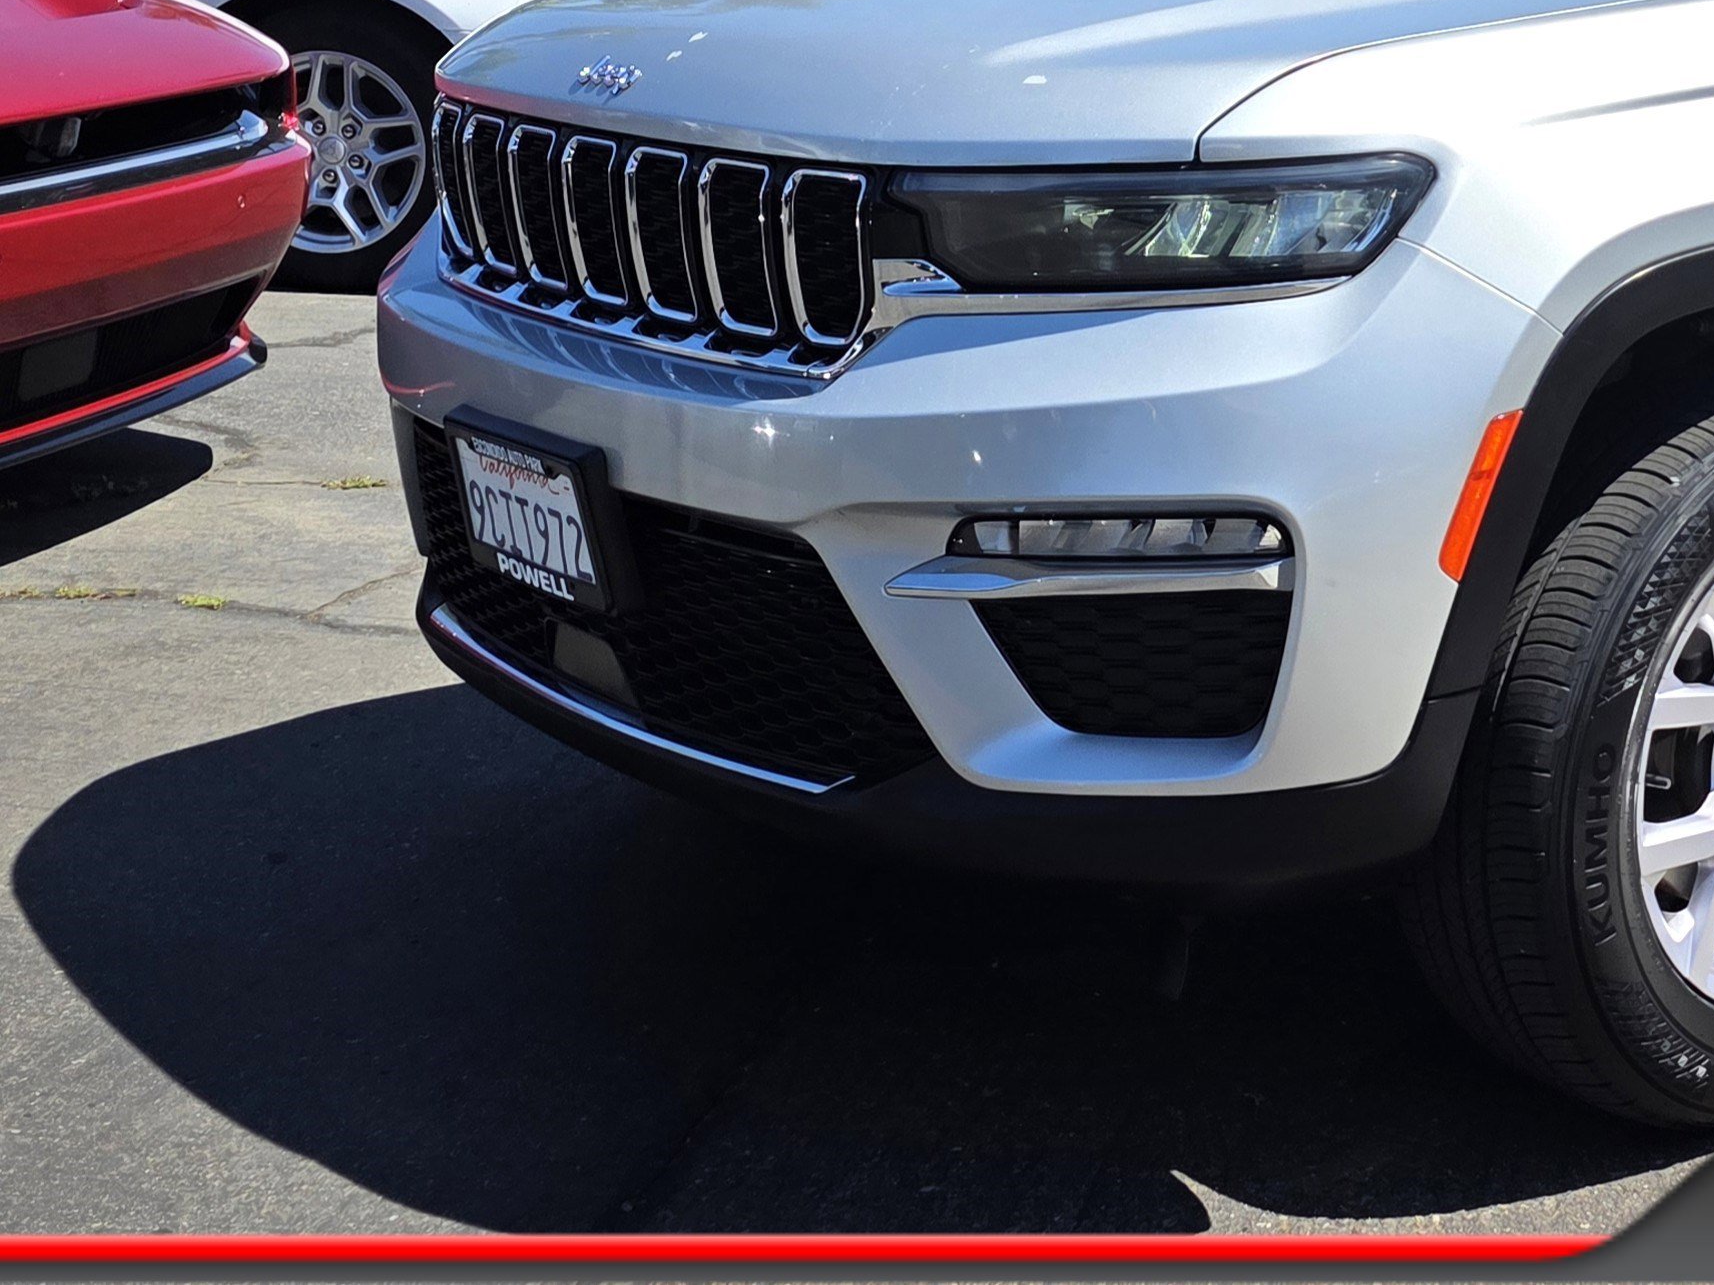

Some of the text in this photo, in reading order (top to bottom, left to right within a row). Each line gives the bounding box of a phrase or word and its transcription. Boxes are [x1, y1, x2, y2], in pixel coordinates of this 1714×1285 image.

[579, 55, 643, 94] Jeep
[469, 479, 593, 583] 9CIT972
[496, 551, 575, 602] POWELL
[1584, 743, 1616, 946] KUMHO
